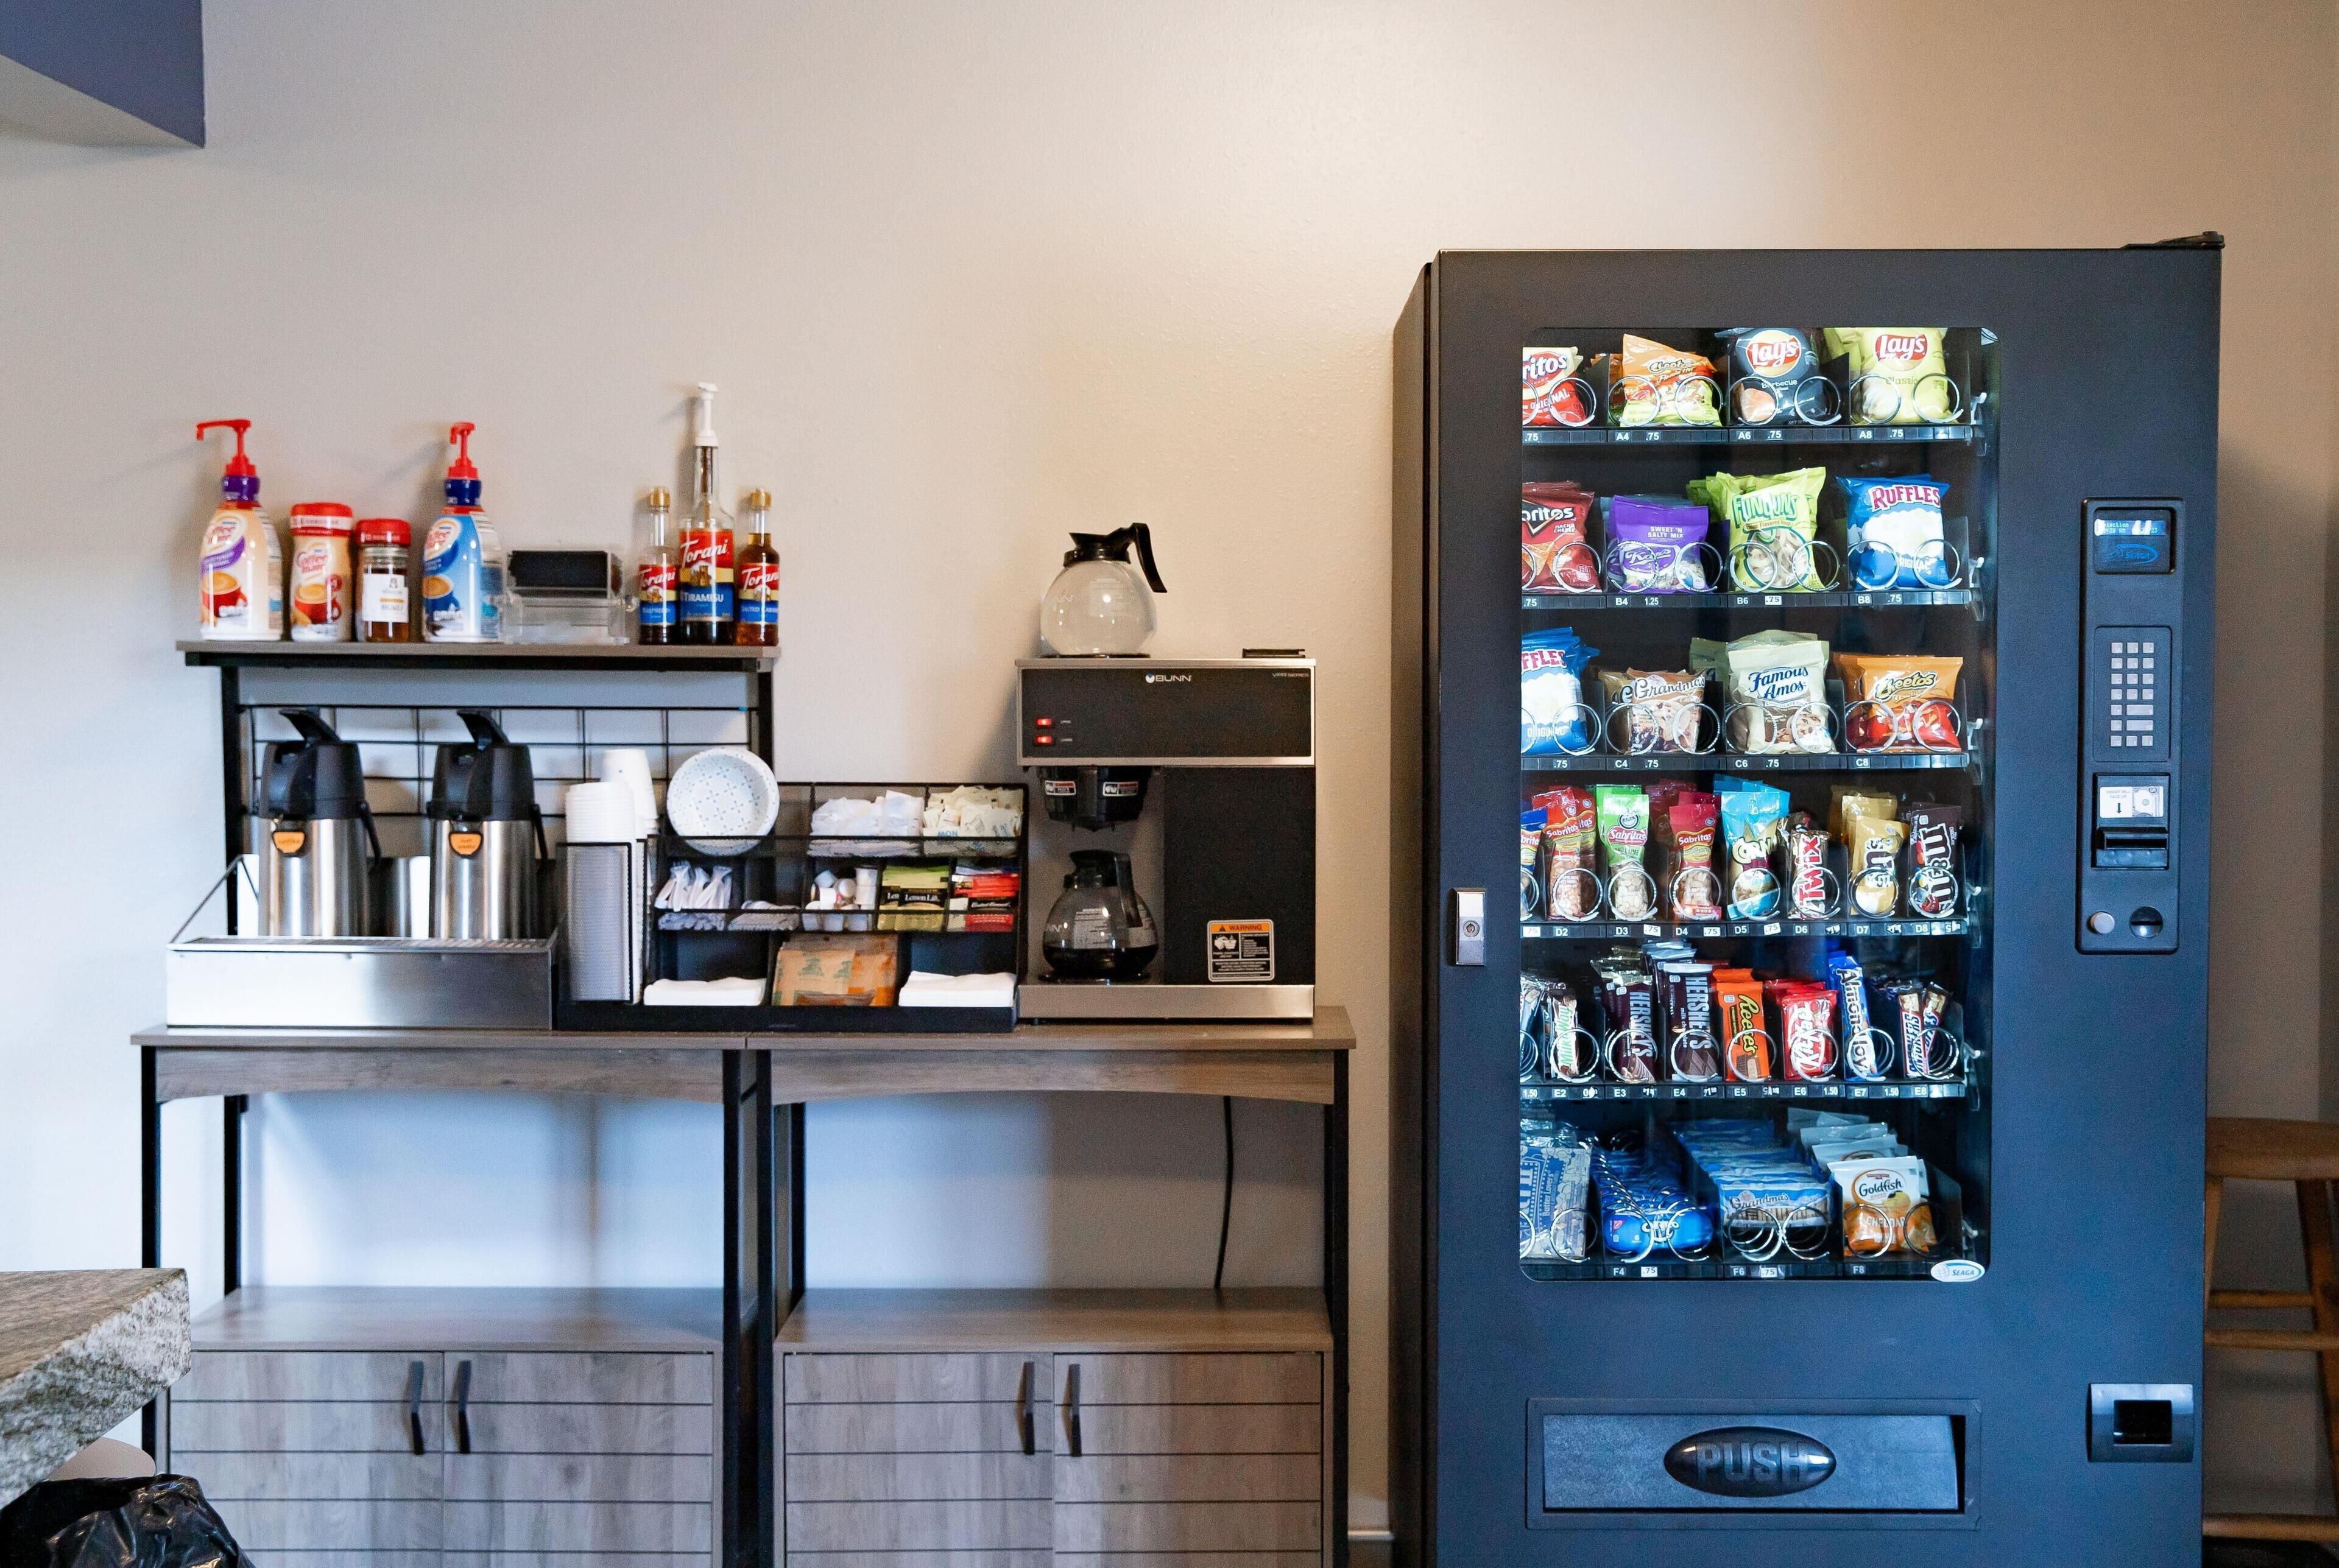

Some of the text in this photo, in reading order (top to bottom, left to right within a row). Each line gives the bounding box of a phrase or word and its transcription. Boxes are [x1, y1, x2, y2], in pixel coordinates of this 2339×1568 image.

[1752, 338, 1798, 367] Lay's
[1880, 335, 1925, 360] Lay's
[1522, 355, 1568, 380] ritos
[1525, 433, 1539, 441] .75
[1871, 485, 1940, 509] RUFFLES
[1522, 507, 1574, 521] oritos
[682, 539, 729, 568] Torani
[1522, 650, 1566, 669] FFLES
[1635, 675, 1706, 699] Grandma's
[1749, 667, 1808, 693] Famous
[1877, 672, 1935, 699] Cheetos
[1758, 680, 1805, 699] Amos
[1546, 824, 1578, 838] Sabritas
[1609, 828, 1647, 840] Sabritas
[1678, 833, 1712, 845] Sabritas
[1676, 927, 1688, 935] D4
[1795, 925, 1808, 933] D6
[1916, 924, 1928, 933] D8
[1738, 994, 1760, 1054] Reese's
[1823, 1087, 1838, 1095] 1.50
[1884, 1088, 1899, 1096] 1.50
[1859, 1178, 1902, 1197] Goldfish
[1542, 1195, 1551, 1217] Butter
[1730, 1192, 1789, 1209] Grandma's
[1733, 1267, 1745, 1275] F6
[1854, 1265, 1864, 1274] F8
[1952, 1268, 1975, 1277] SEAGA
[1696, 1441, 1808, 1482] PUSH
